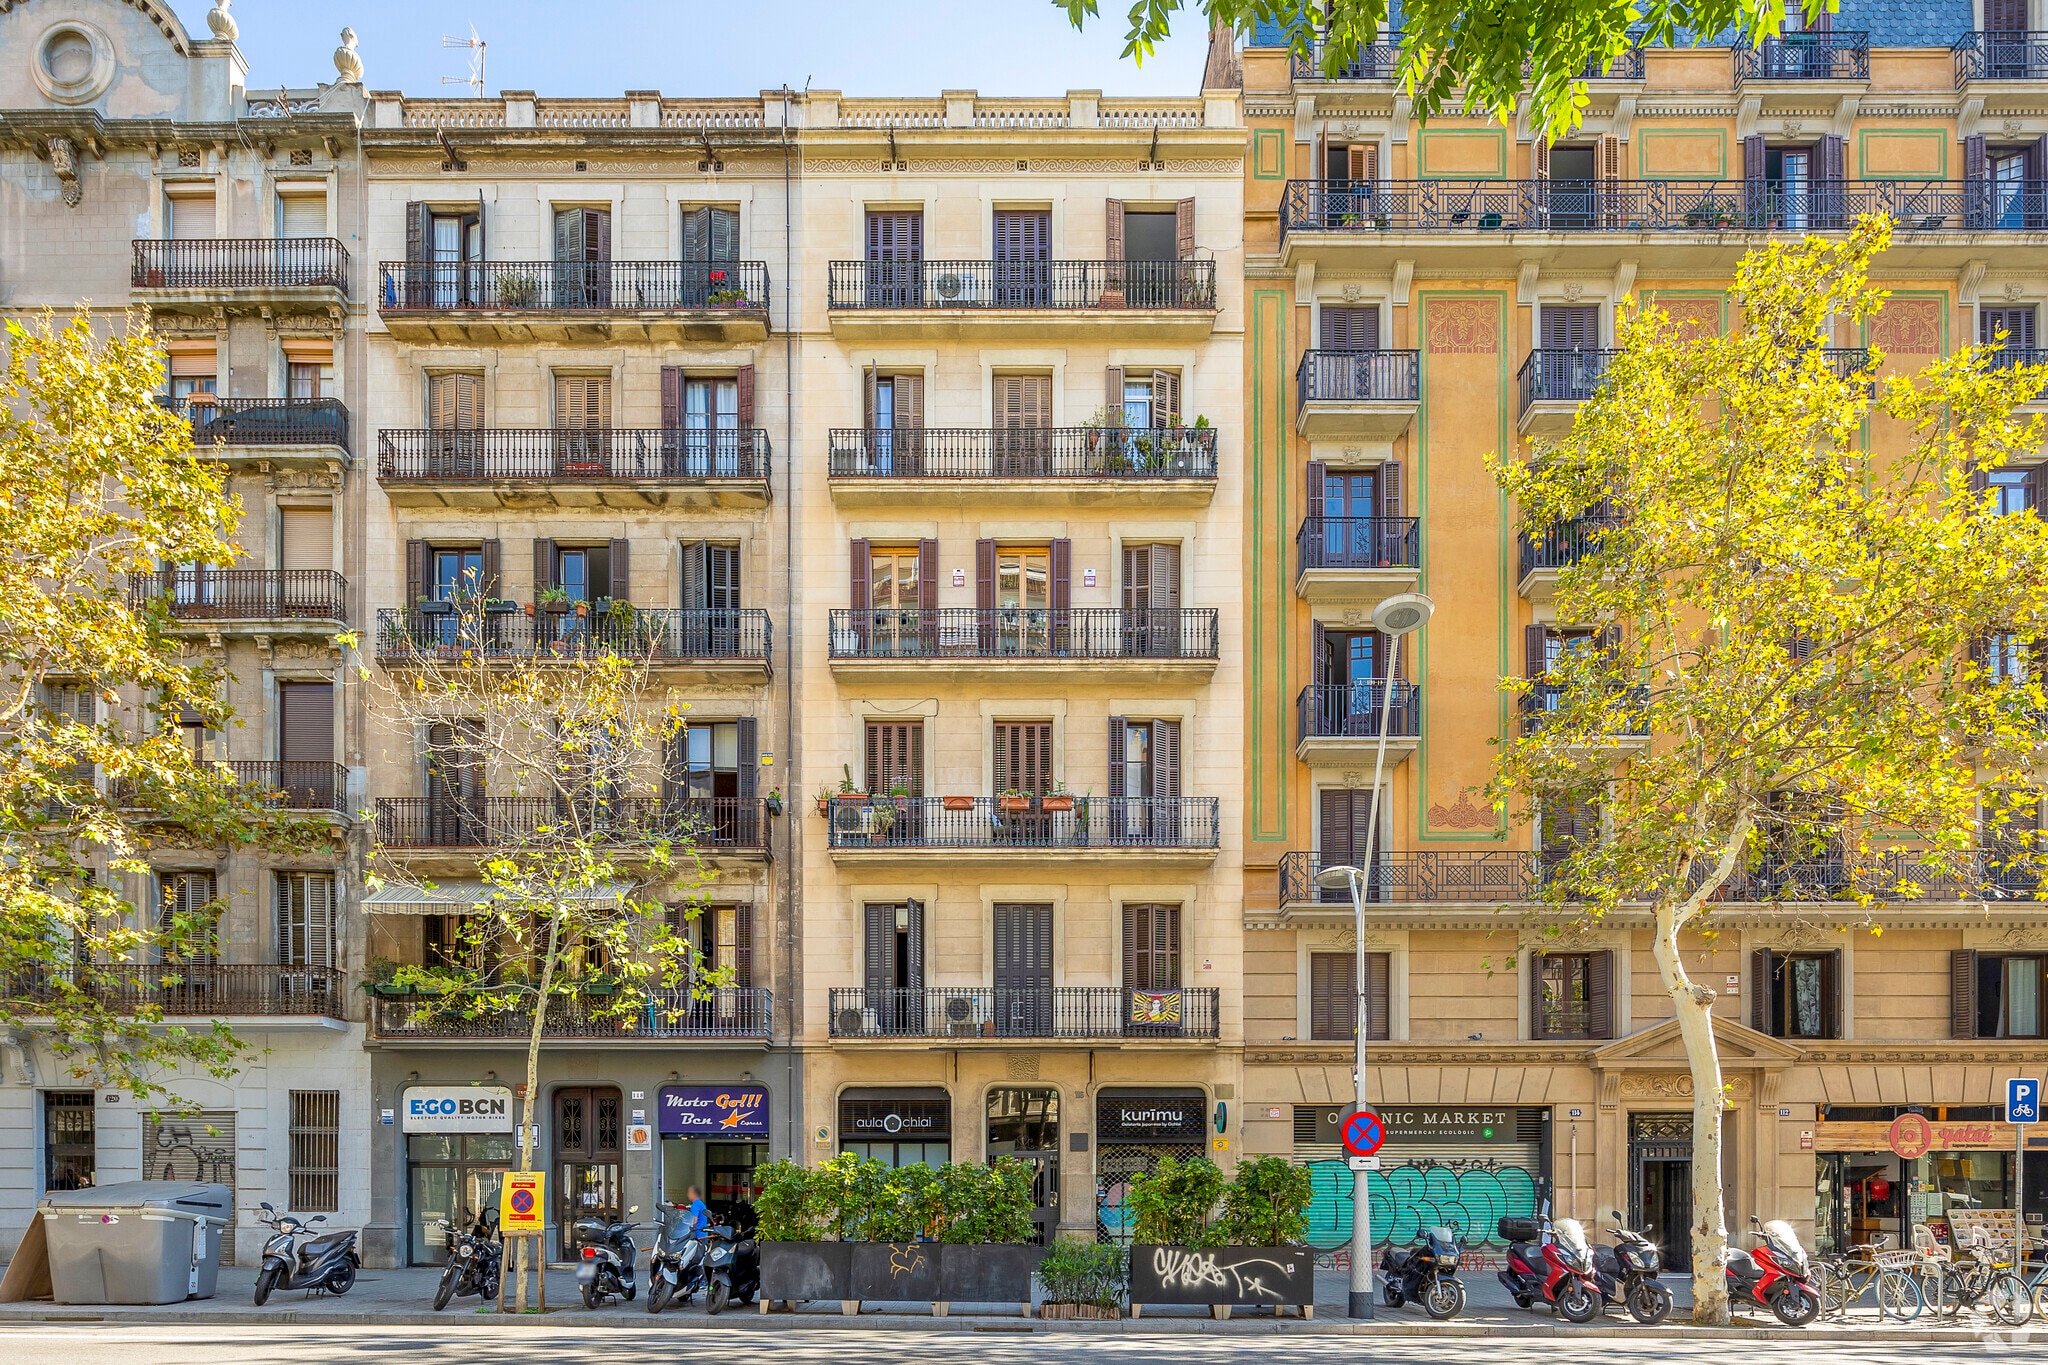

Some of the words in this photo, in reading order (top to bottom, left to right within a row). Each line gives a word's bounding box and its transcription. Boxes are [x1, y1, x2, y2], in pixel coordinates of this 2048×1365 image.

[665, 1094, 714, 1107] Moto
[715, 1093, 763, 1109] Go!!!
[2016, 1085, 2031, 1102] P
[459, 1099, 505, 1115] BCN
[680, 1112, 713, 1125] Bcn
[856, 1116, 883, 1128] aula
[1327, 1112, 1414, 1125] ONIC
[1423, 1112, 1506, 1124] MARKET
[1939, 1124, 1992, 1149] yatai
